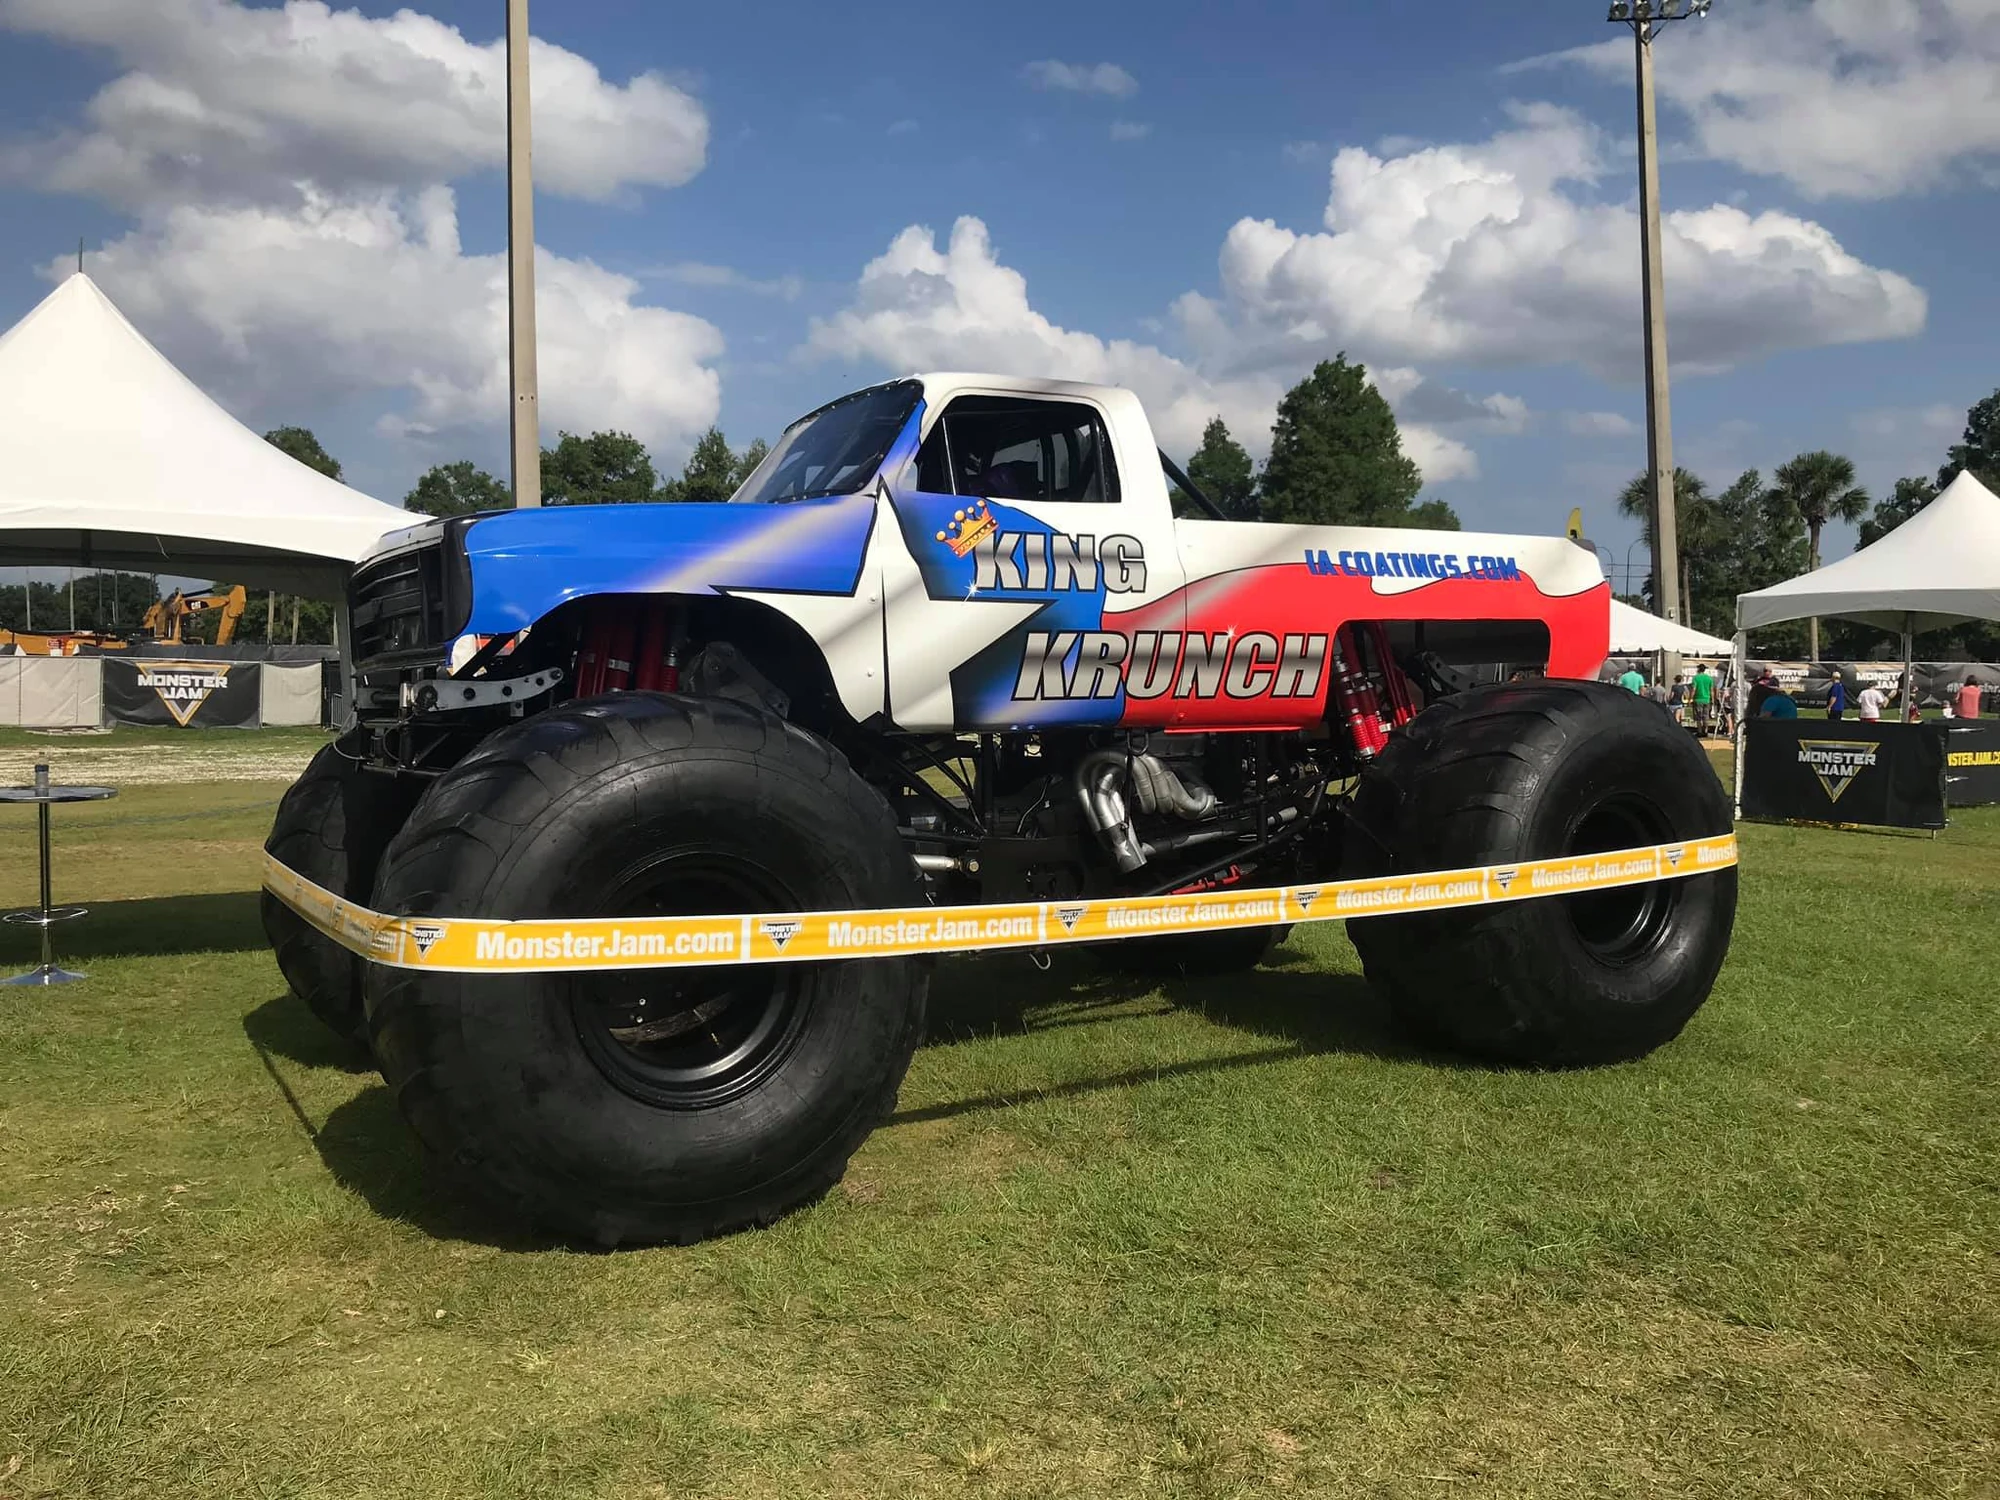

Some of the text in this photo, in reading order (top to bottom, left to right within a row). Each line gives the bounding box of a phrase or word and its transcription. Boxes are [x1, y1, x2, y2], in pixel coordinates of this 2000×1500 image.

[974, 532, 1147, 593] KING
[1338, 551, 1522, 581] COATINGS.COM
[1012, 629, 1329, 700] KRUNCH
[137, 674, 228, 688] MONSTER
[164, 687, 203, 699] JAM
[1798, 750, 1876, 765] MONSTER
[1819, 763, 1853, 776] JAM
[1531, 858, 1653, 889] MonsterJam.com
[1336, 880, 1479, 910] MonsterJam.com
[1106, 899, 1275, 929] MonsterJam.com
[476, 929, 734, 960] MonsterJam.com
[828, 915, 1032, 947] MonsterJam.com
